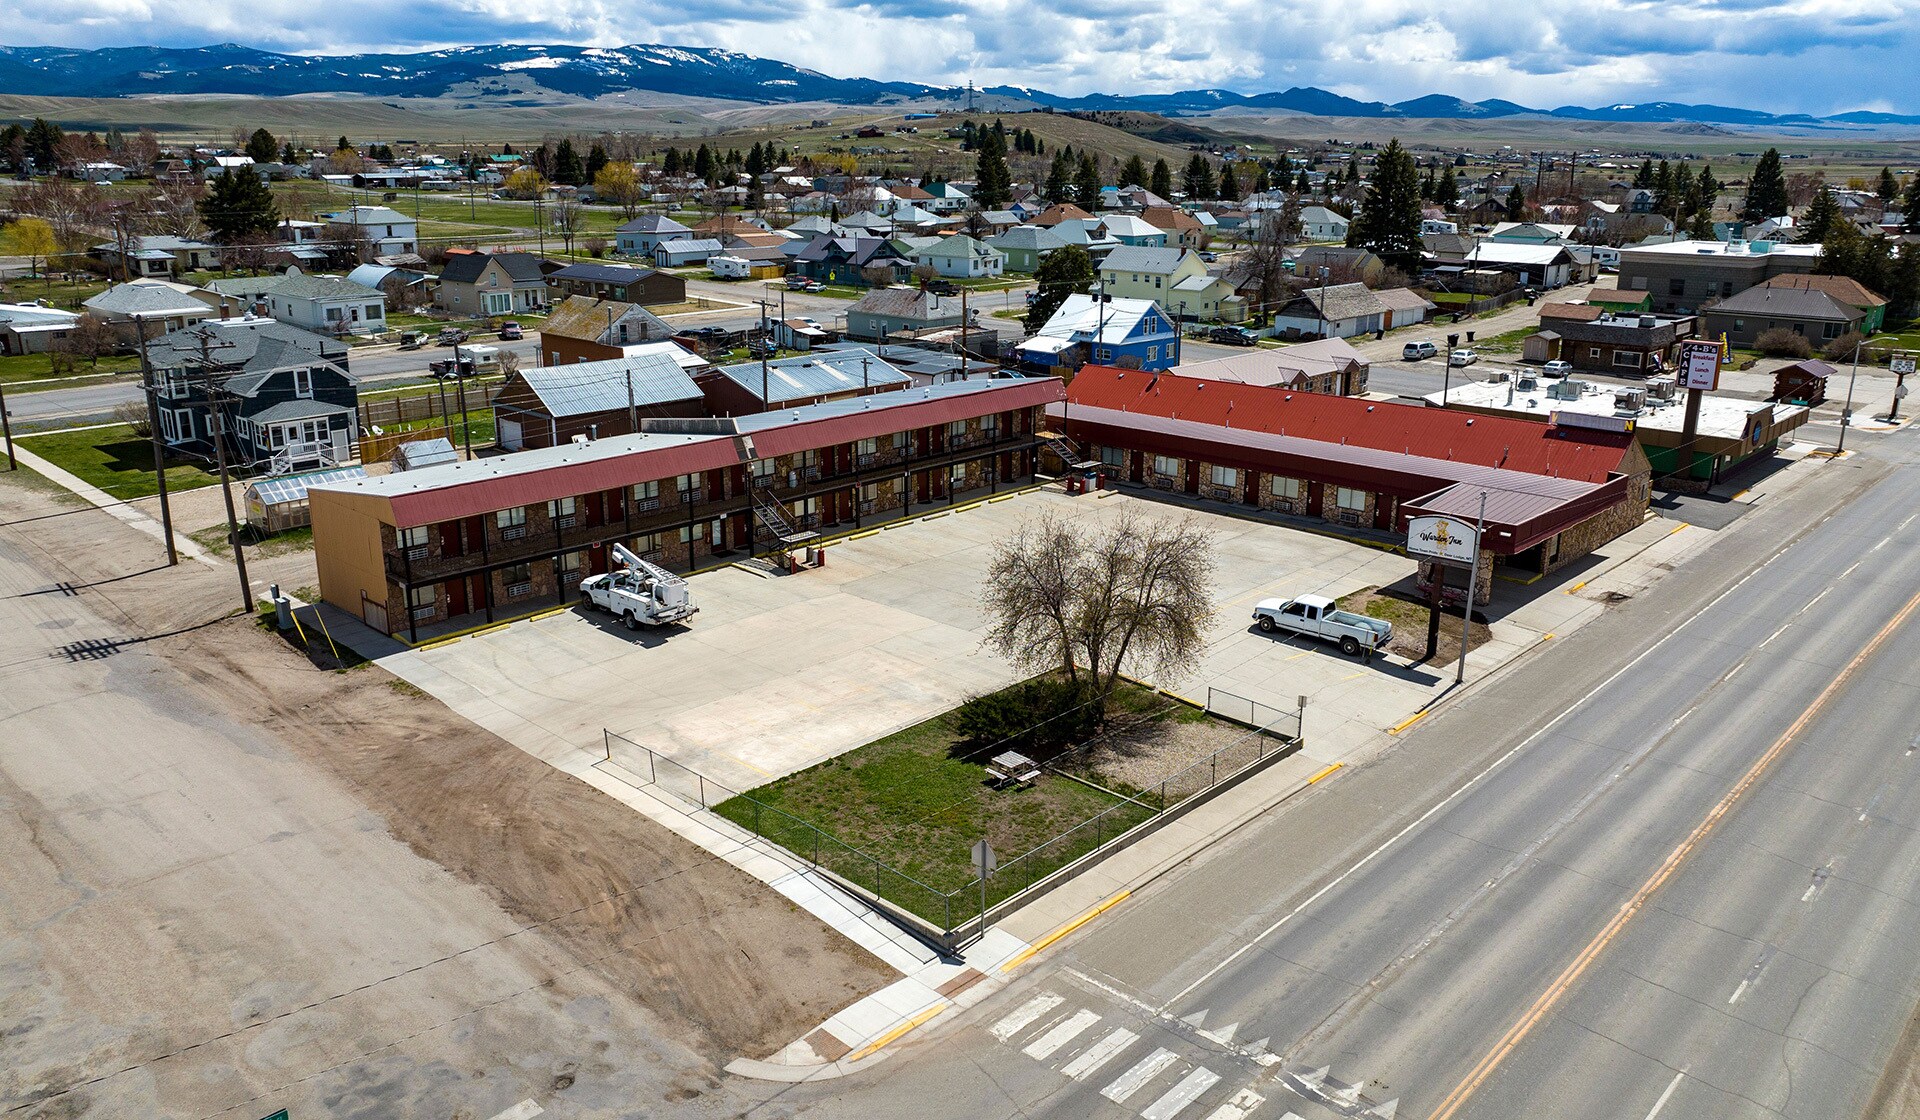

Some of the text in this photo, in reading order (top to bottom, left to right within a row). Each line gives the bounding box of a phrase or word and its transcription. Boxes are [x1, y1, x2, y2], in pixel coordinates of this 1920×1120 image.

[1692, 345, 1716, 353] 4-B's
[1679, 352, 1690, 385] CAFE
[1419, 531, 1463, 545] Warden Inn
